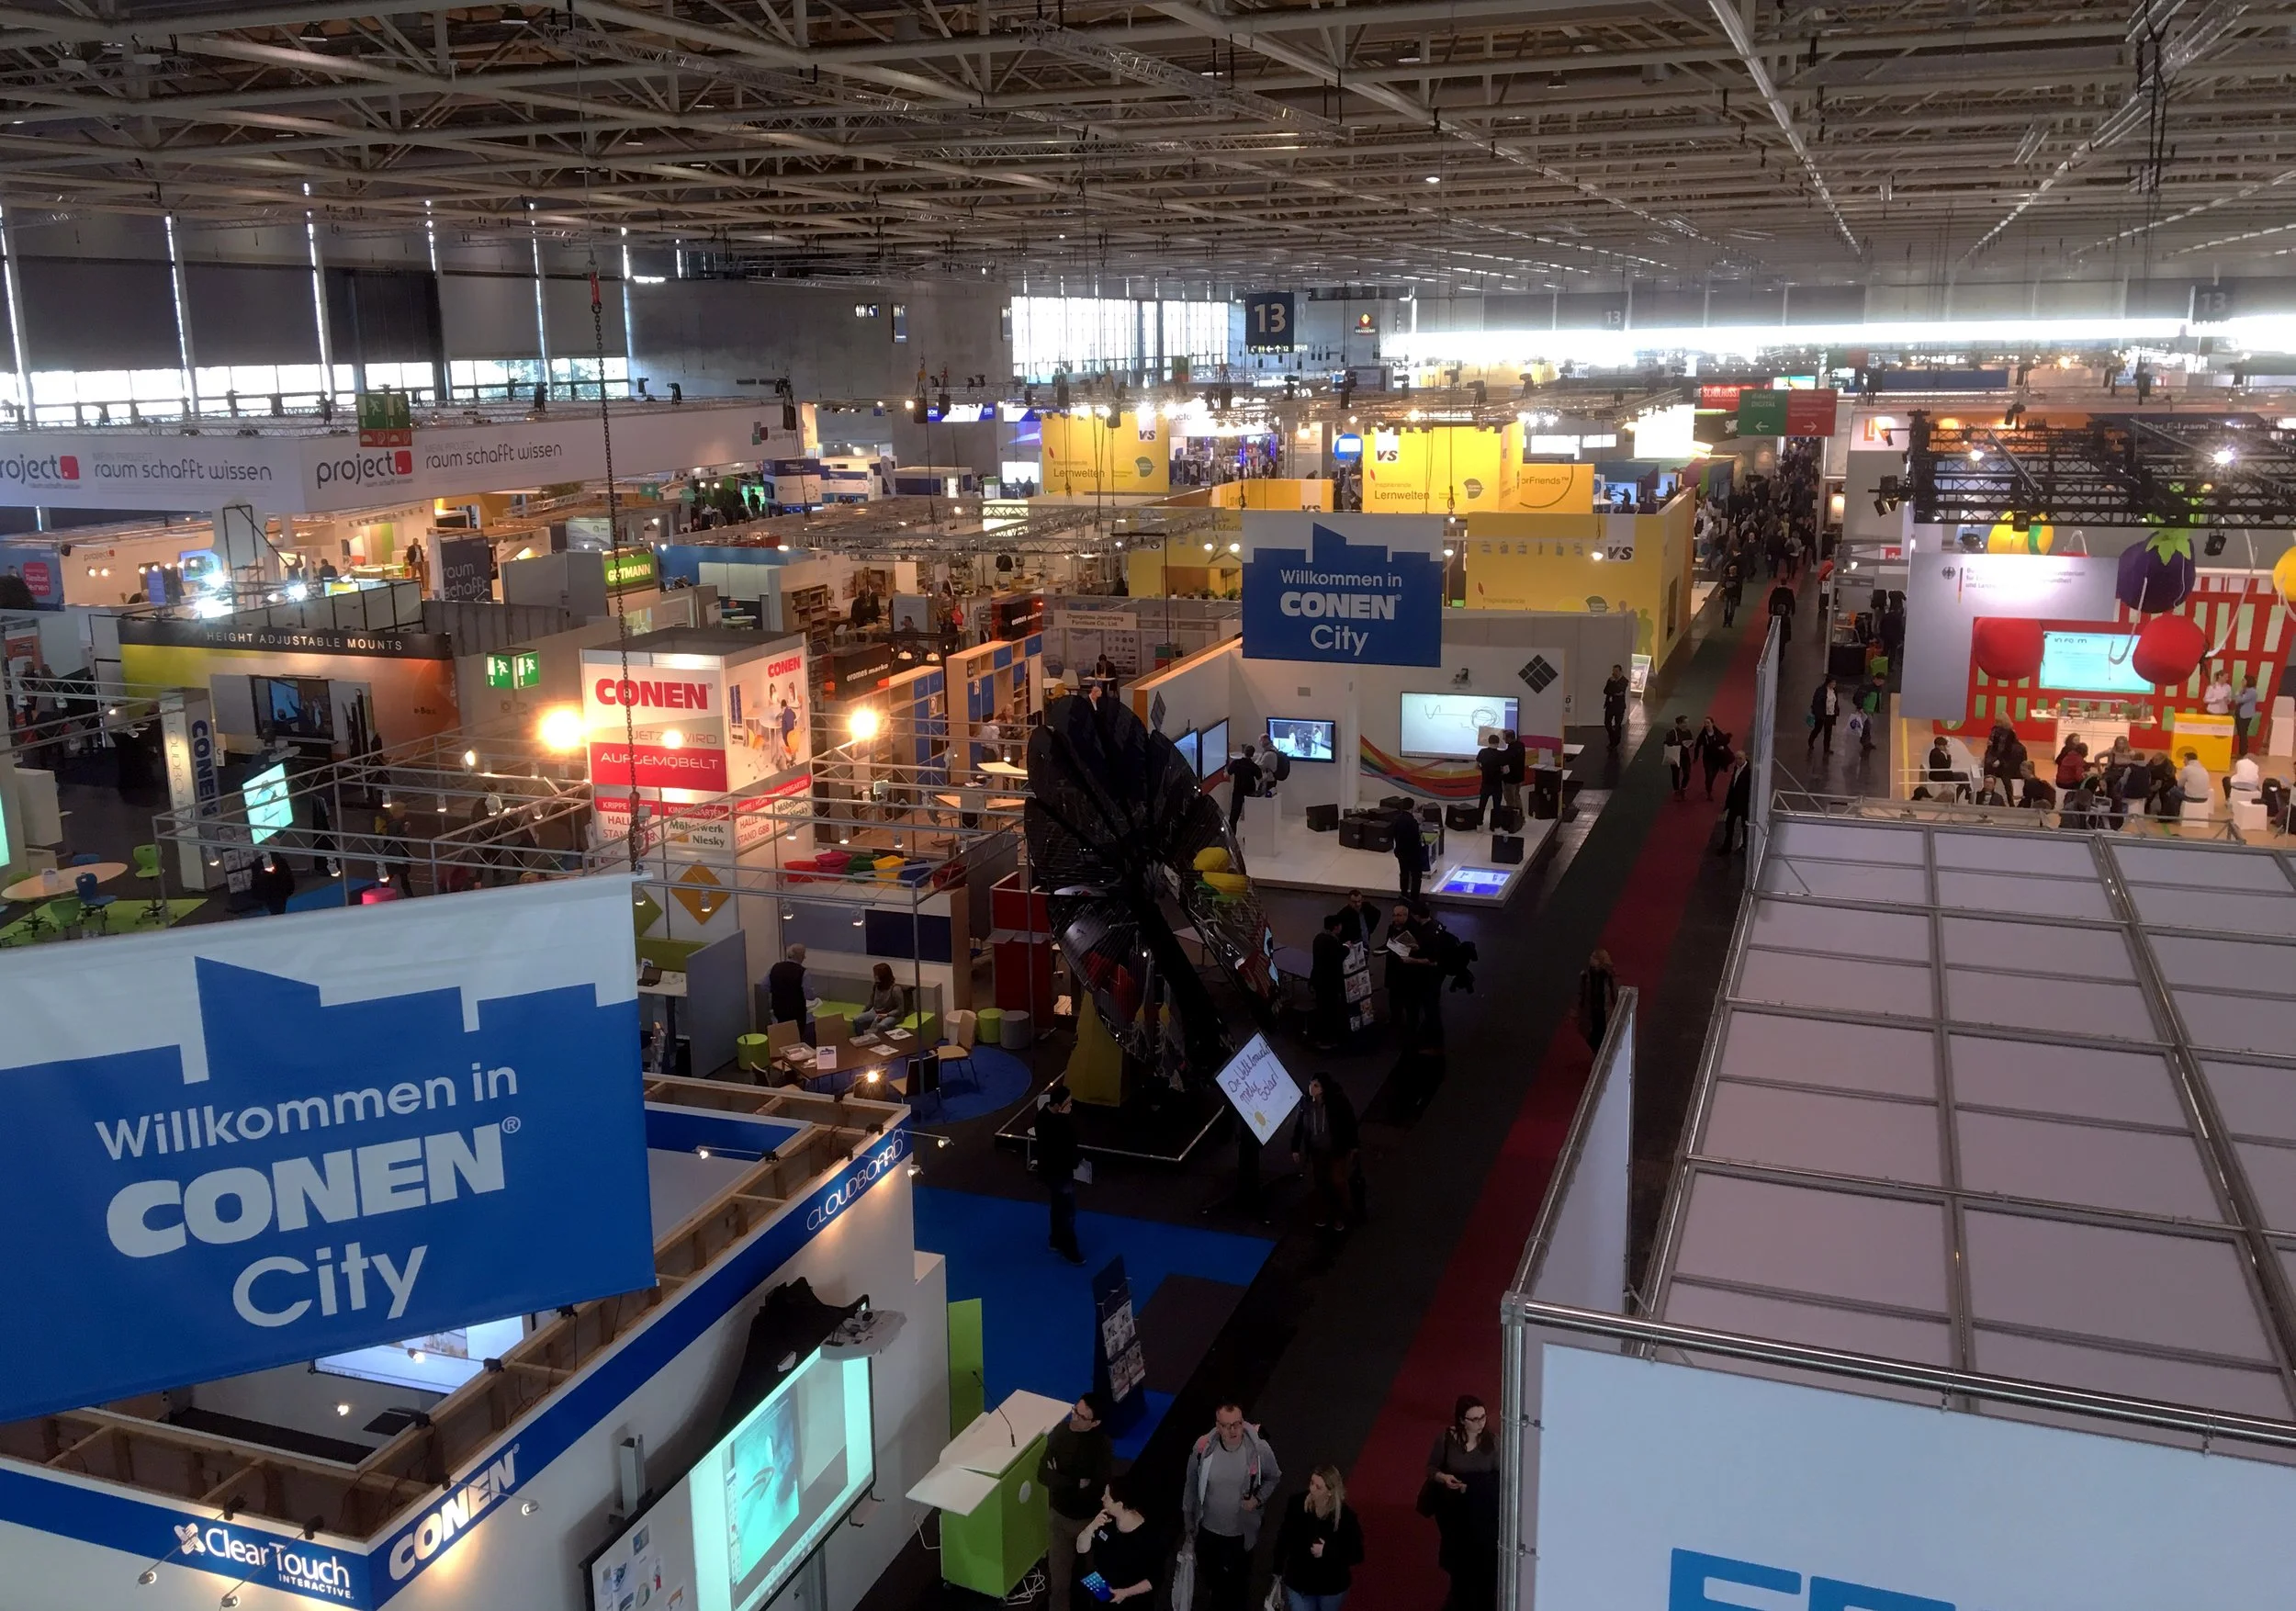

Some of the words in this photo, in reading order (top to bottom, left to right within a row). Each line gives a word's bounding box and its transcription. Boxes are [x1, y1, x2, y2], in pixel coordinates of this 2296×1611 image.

[2200, 292, 2226, 312] 13
[1255, 303, 1286, 332] 13
[1605, 310, 1621, 324] 13
[1139, 430, 1155, 441] VS
[426, 453, 463, 469] raum
[467, 444, 514, 465] schafft
[517, 442, 562, 460] wissen
[1377, 450, 1398, 461] VS
[95, 462, 138, 478] raum
[142, 459, 204, 479] schafft
[208, 460, 273, 480] wissen
[317, 451, 395, 489] project
[1374, 490, 1430, 501] Lernwelten
[1607, 546, 1633, 560] VS
[1280, 569, 1382, 587] Willkommen
[1388, 572, 1402, 587] in
[207, 631, 253, 643] HEIGHT
[259, 634, 341, 648] ADJUSTABLE
[347, 638, 402, 650] MOUNTS
[1311, 625, 1369, 656] City
[767, 656, 801, 678] CONEN
[595, 678, 708, 710] CONEN
[634, 730, 669, 741] JETZ
[601, 750, 718, 770] AUFGEMÖBELT
[602, 802, 627, 810] KRIPPE
[692, 835, 726, 848] Niesky
[95, 1071, 457, 1161] Willkommen
[470, 1062, 517, 1104] in
[232, 1242, 428, 1328] City
